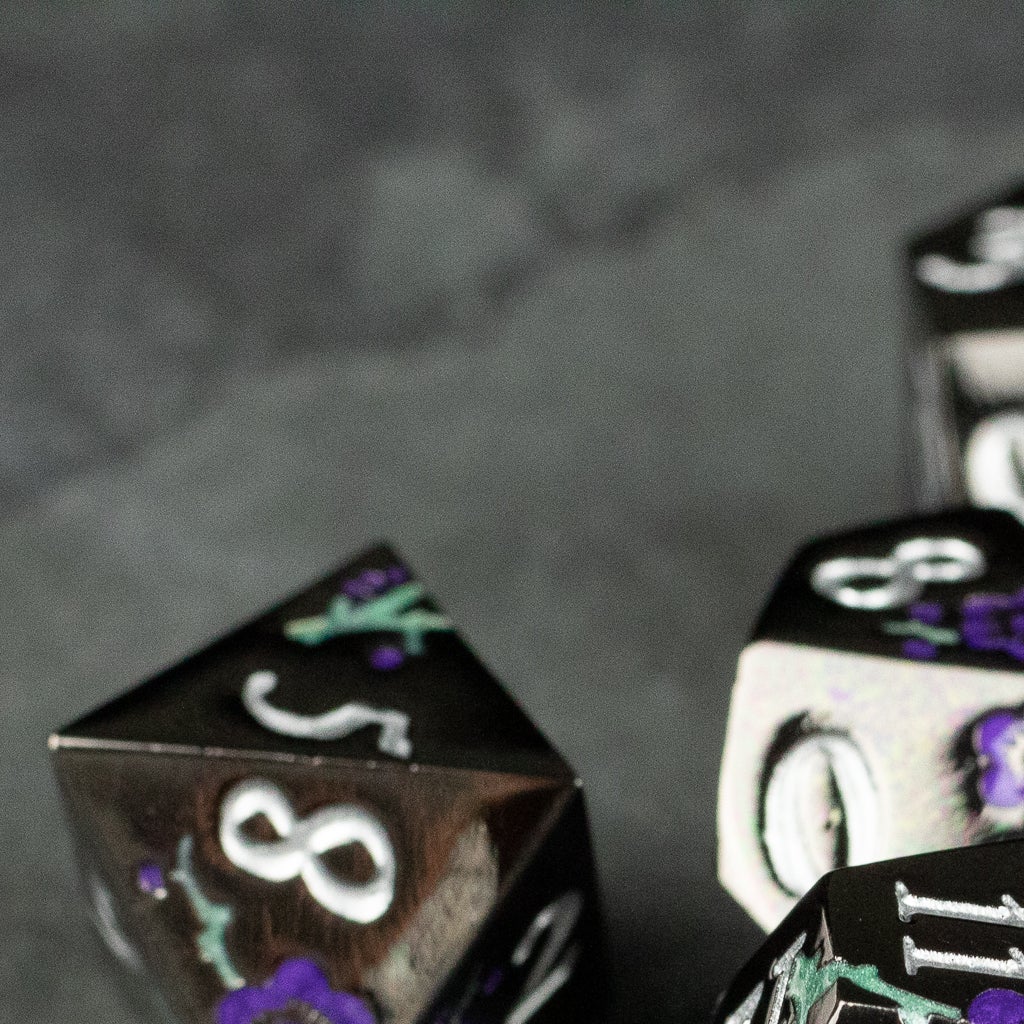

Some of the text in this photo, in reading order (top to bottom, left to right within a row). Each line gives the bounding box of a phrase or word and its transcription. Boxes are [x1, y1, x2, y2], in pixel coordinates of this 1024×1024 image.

[811, 537, 985, 609] 8
[242, 669, 411, 757] 5
[219, 780, 395, 923] 8
